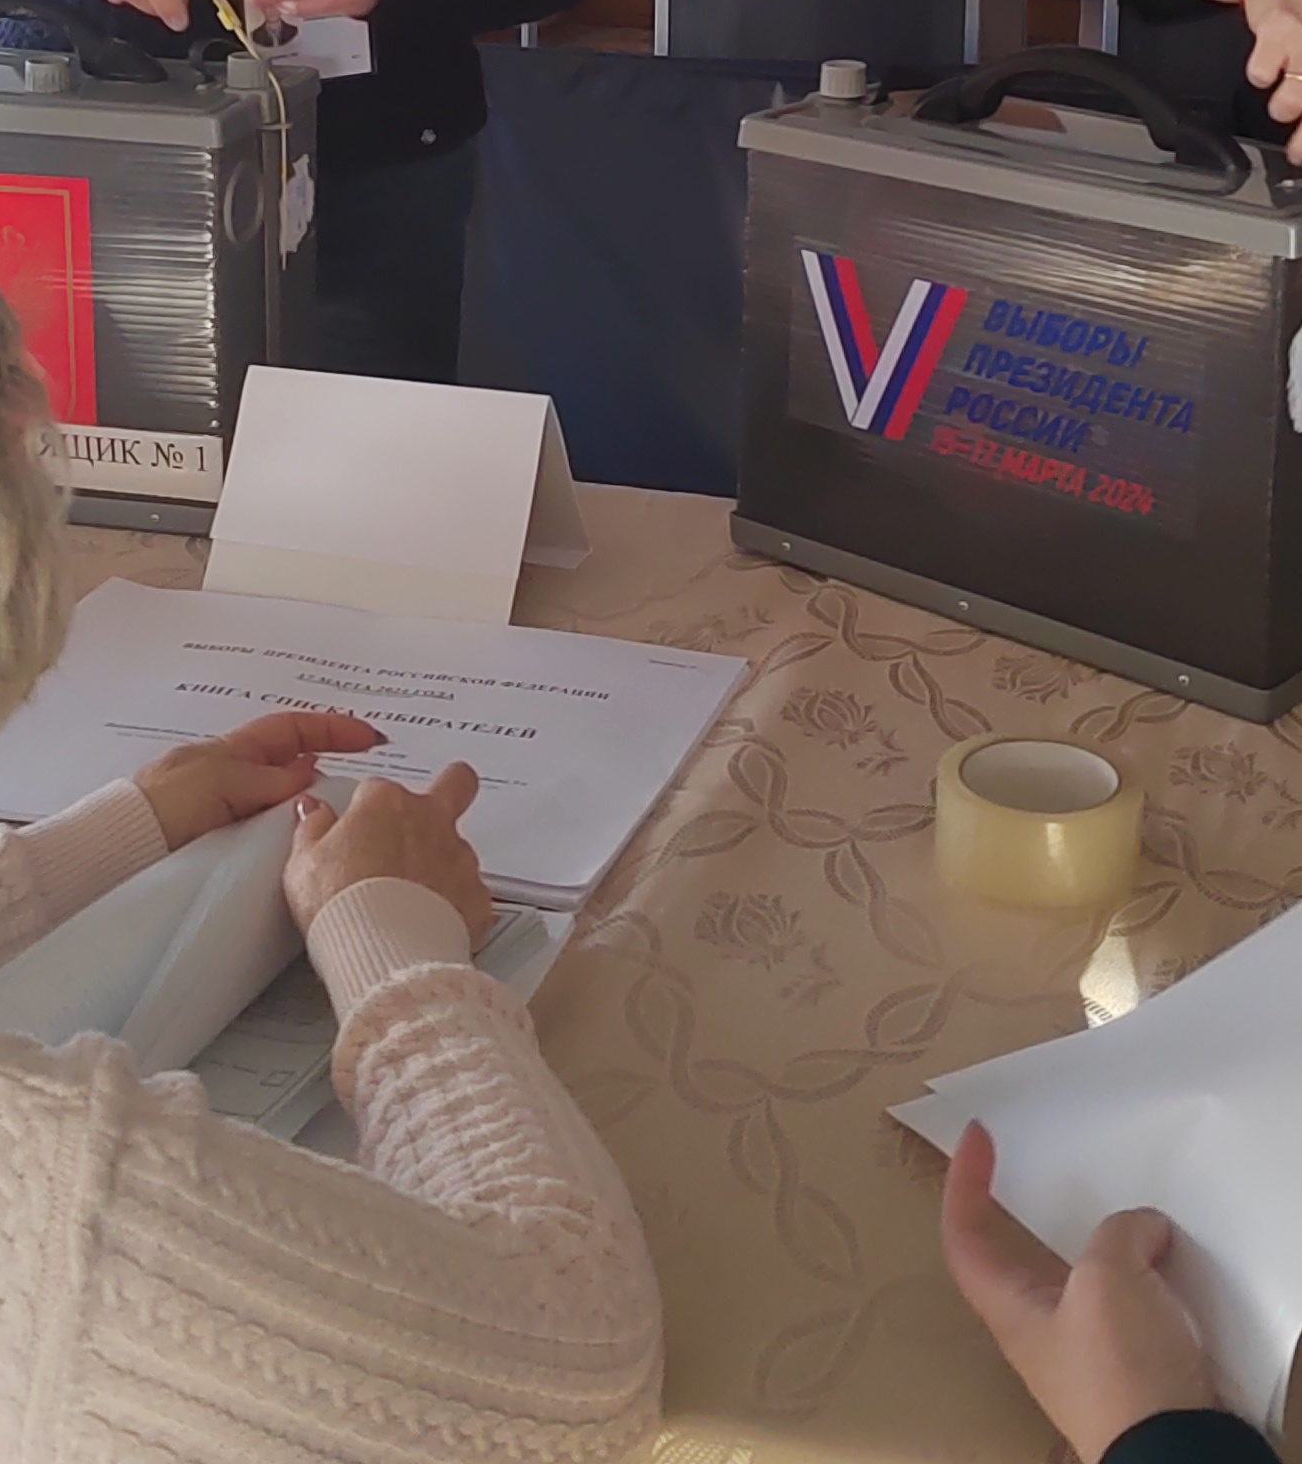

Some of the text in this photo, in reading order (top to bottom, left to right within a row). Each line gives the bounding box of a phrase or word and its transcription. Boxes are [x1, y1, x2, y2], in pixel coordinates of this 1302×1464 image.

[983, 299, 1148, 368] ВЫБОРЫ
[945, 386, 1090, 454] РОССИИ
[963, 343, 1194, 434] ПРЕЗИДЕНТА
[150, 441, 185, 469] №
[197, 446, 208, 472] 1
[998, 446, 1087, 498] МАРТА
[1087, 473, 1155, 516] 2024
[262, 649, 372, 675] ПРЕЗИДЕНТА
[376, 668, 497, 688] РОССИЙСКОЙ
[499, 680, 611, 701] ФЕДЕРАЦИИ
[174, 683, 538, 740] КНИГА СПИСКА ИЗБИРАТЕЛЕЙ
